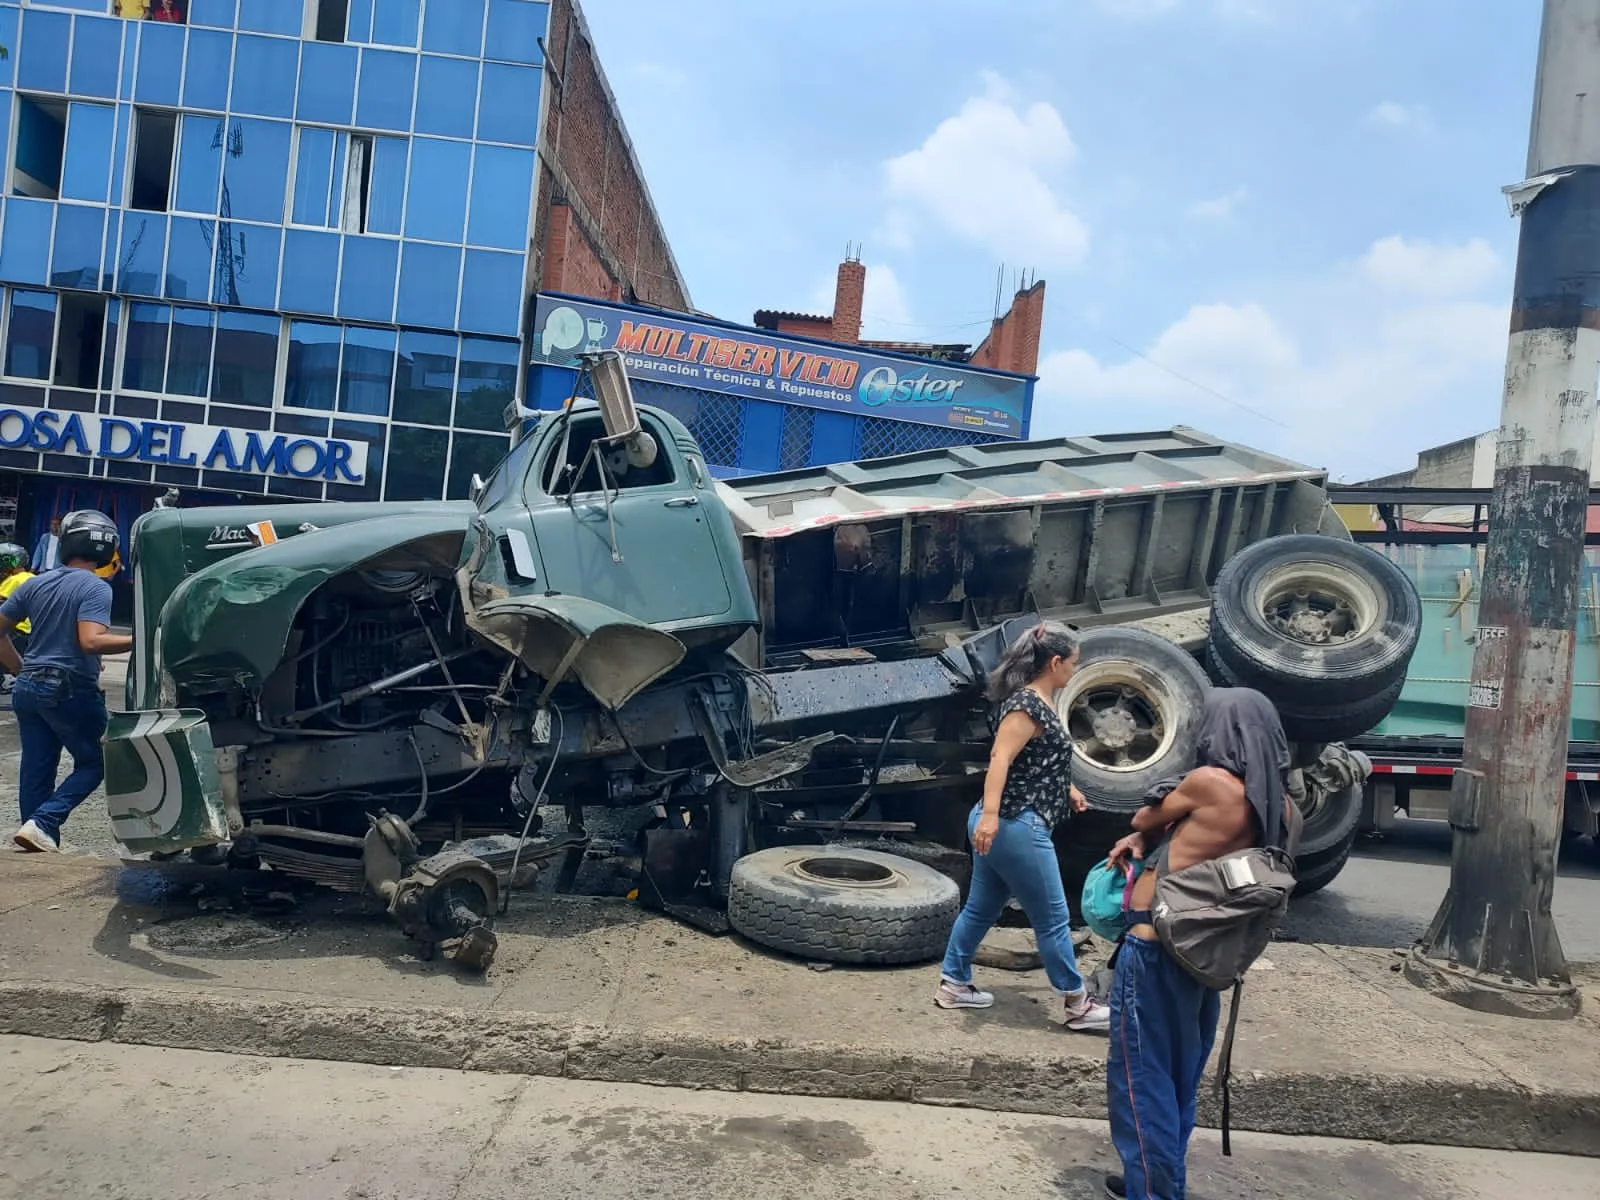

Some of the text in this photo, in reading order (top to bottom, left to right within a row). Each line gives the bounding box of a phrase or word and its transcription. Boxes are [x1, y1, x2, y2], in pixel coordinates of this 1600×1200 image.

[612, 320, 859, 389] MULTISERVICIO
[704, 367, 761, 388] Técnica
[765, 379, 776, 390] &
[781, 381, 852, 402] Repuestos
[859, 366, 964, 407] Oster
[0, 409, 362, 482] OSA DEL AMOR
[207, 525, 249, 541] Mac
